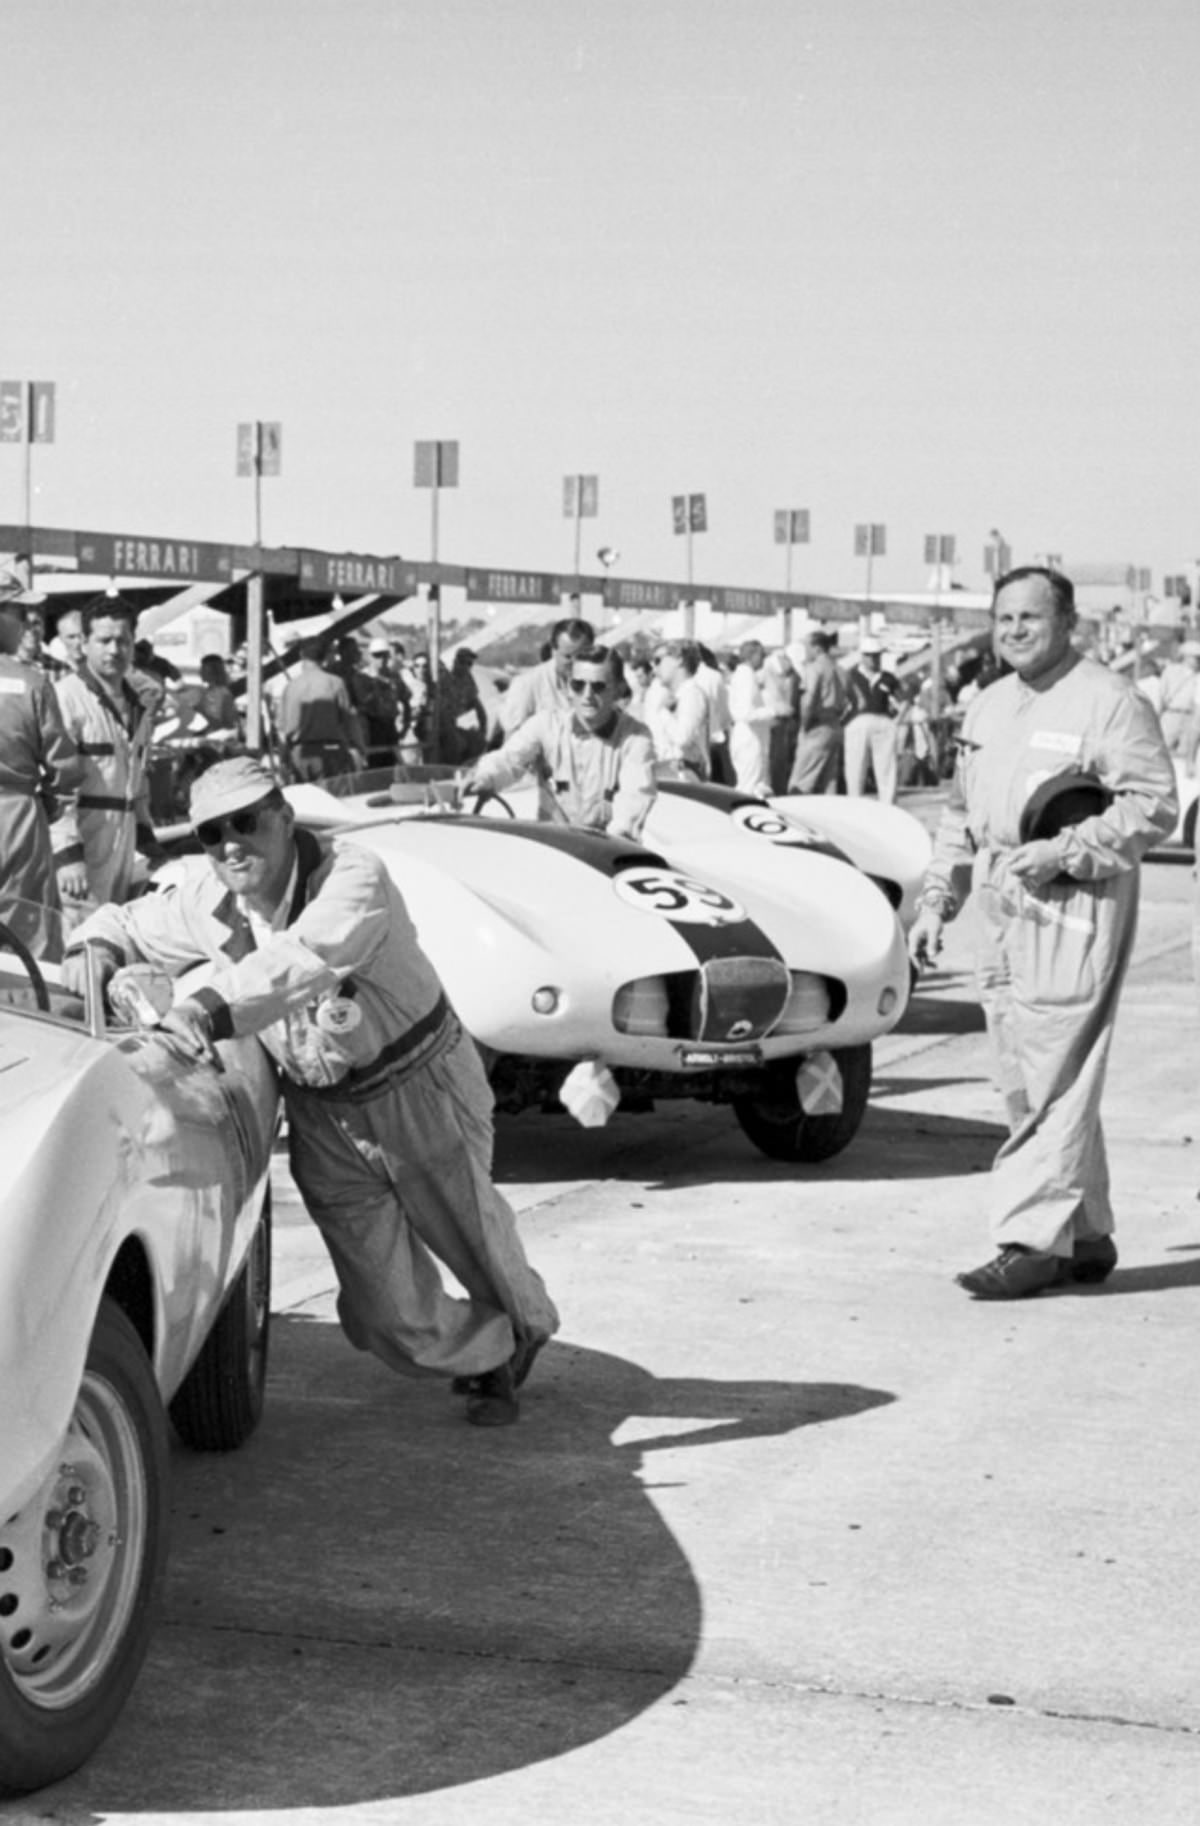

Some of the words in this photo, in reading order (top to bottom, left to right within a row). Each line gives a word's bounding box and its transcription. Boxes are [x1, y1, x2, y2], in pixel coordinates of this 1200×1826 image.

[113, 540, 199, 575] FERRARI
[327, 558, 396, 590] FERRARI
[625, 876, 735, 911] 59
